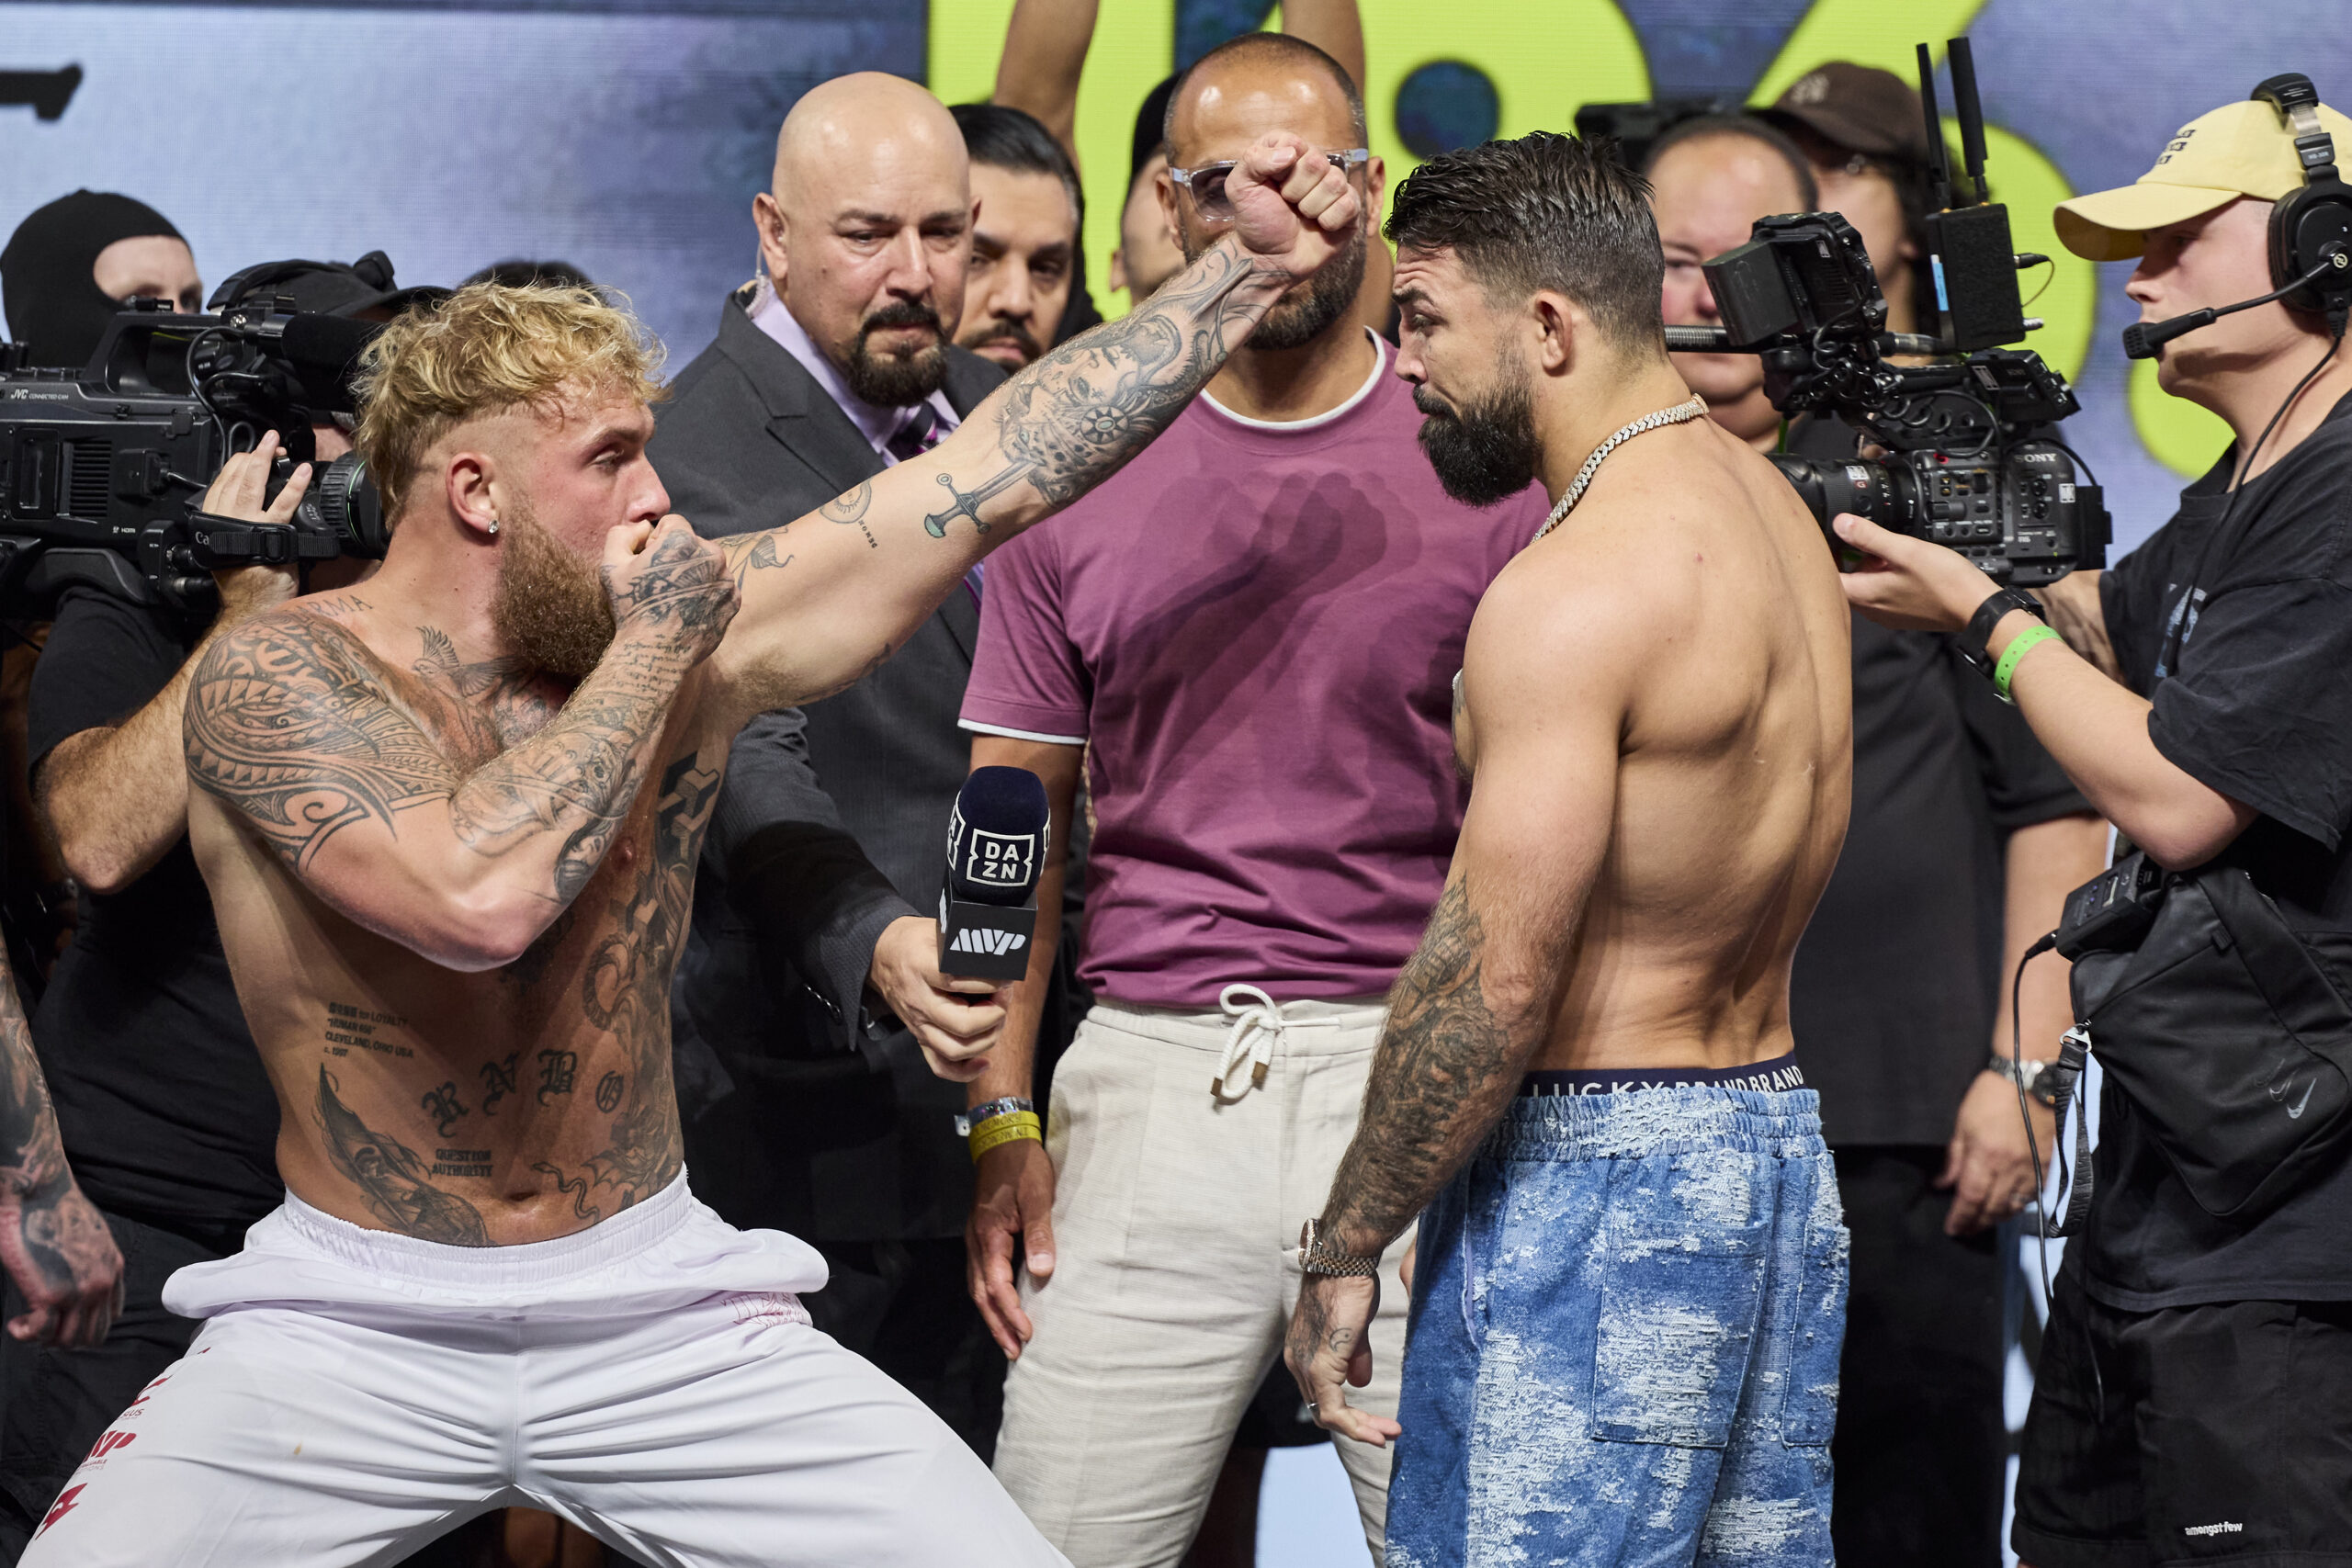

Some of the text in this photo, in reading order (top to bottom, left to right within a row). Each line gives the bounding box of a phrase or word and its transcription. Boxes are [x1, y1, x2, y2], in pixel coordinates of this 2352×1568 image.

[10, 389, 28, 400] JVC
[2015, 453, 2057, 463] SONY
[949, 928, 1026, 955] MVP
[371, 1011, 408, 1027] LOYALTY
[325, 1031, 413, 1059] CLEVELAND, OHIO USA
[1748, 1065, 1804, 1094] BRAND
[435, 1148, 492, 1162] QUESTION
[432, 1161, 494, 1178] AUTHORITY
[85, 1429, 137, 1463] VP
[2184, 1520, 2244, 1536] amongst few
